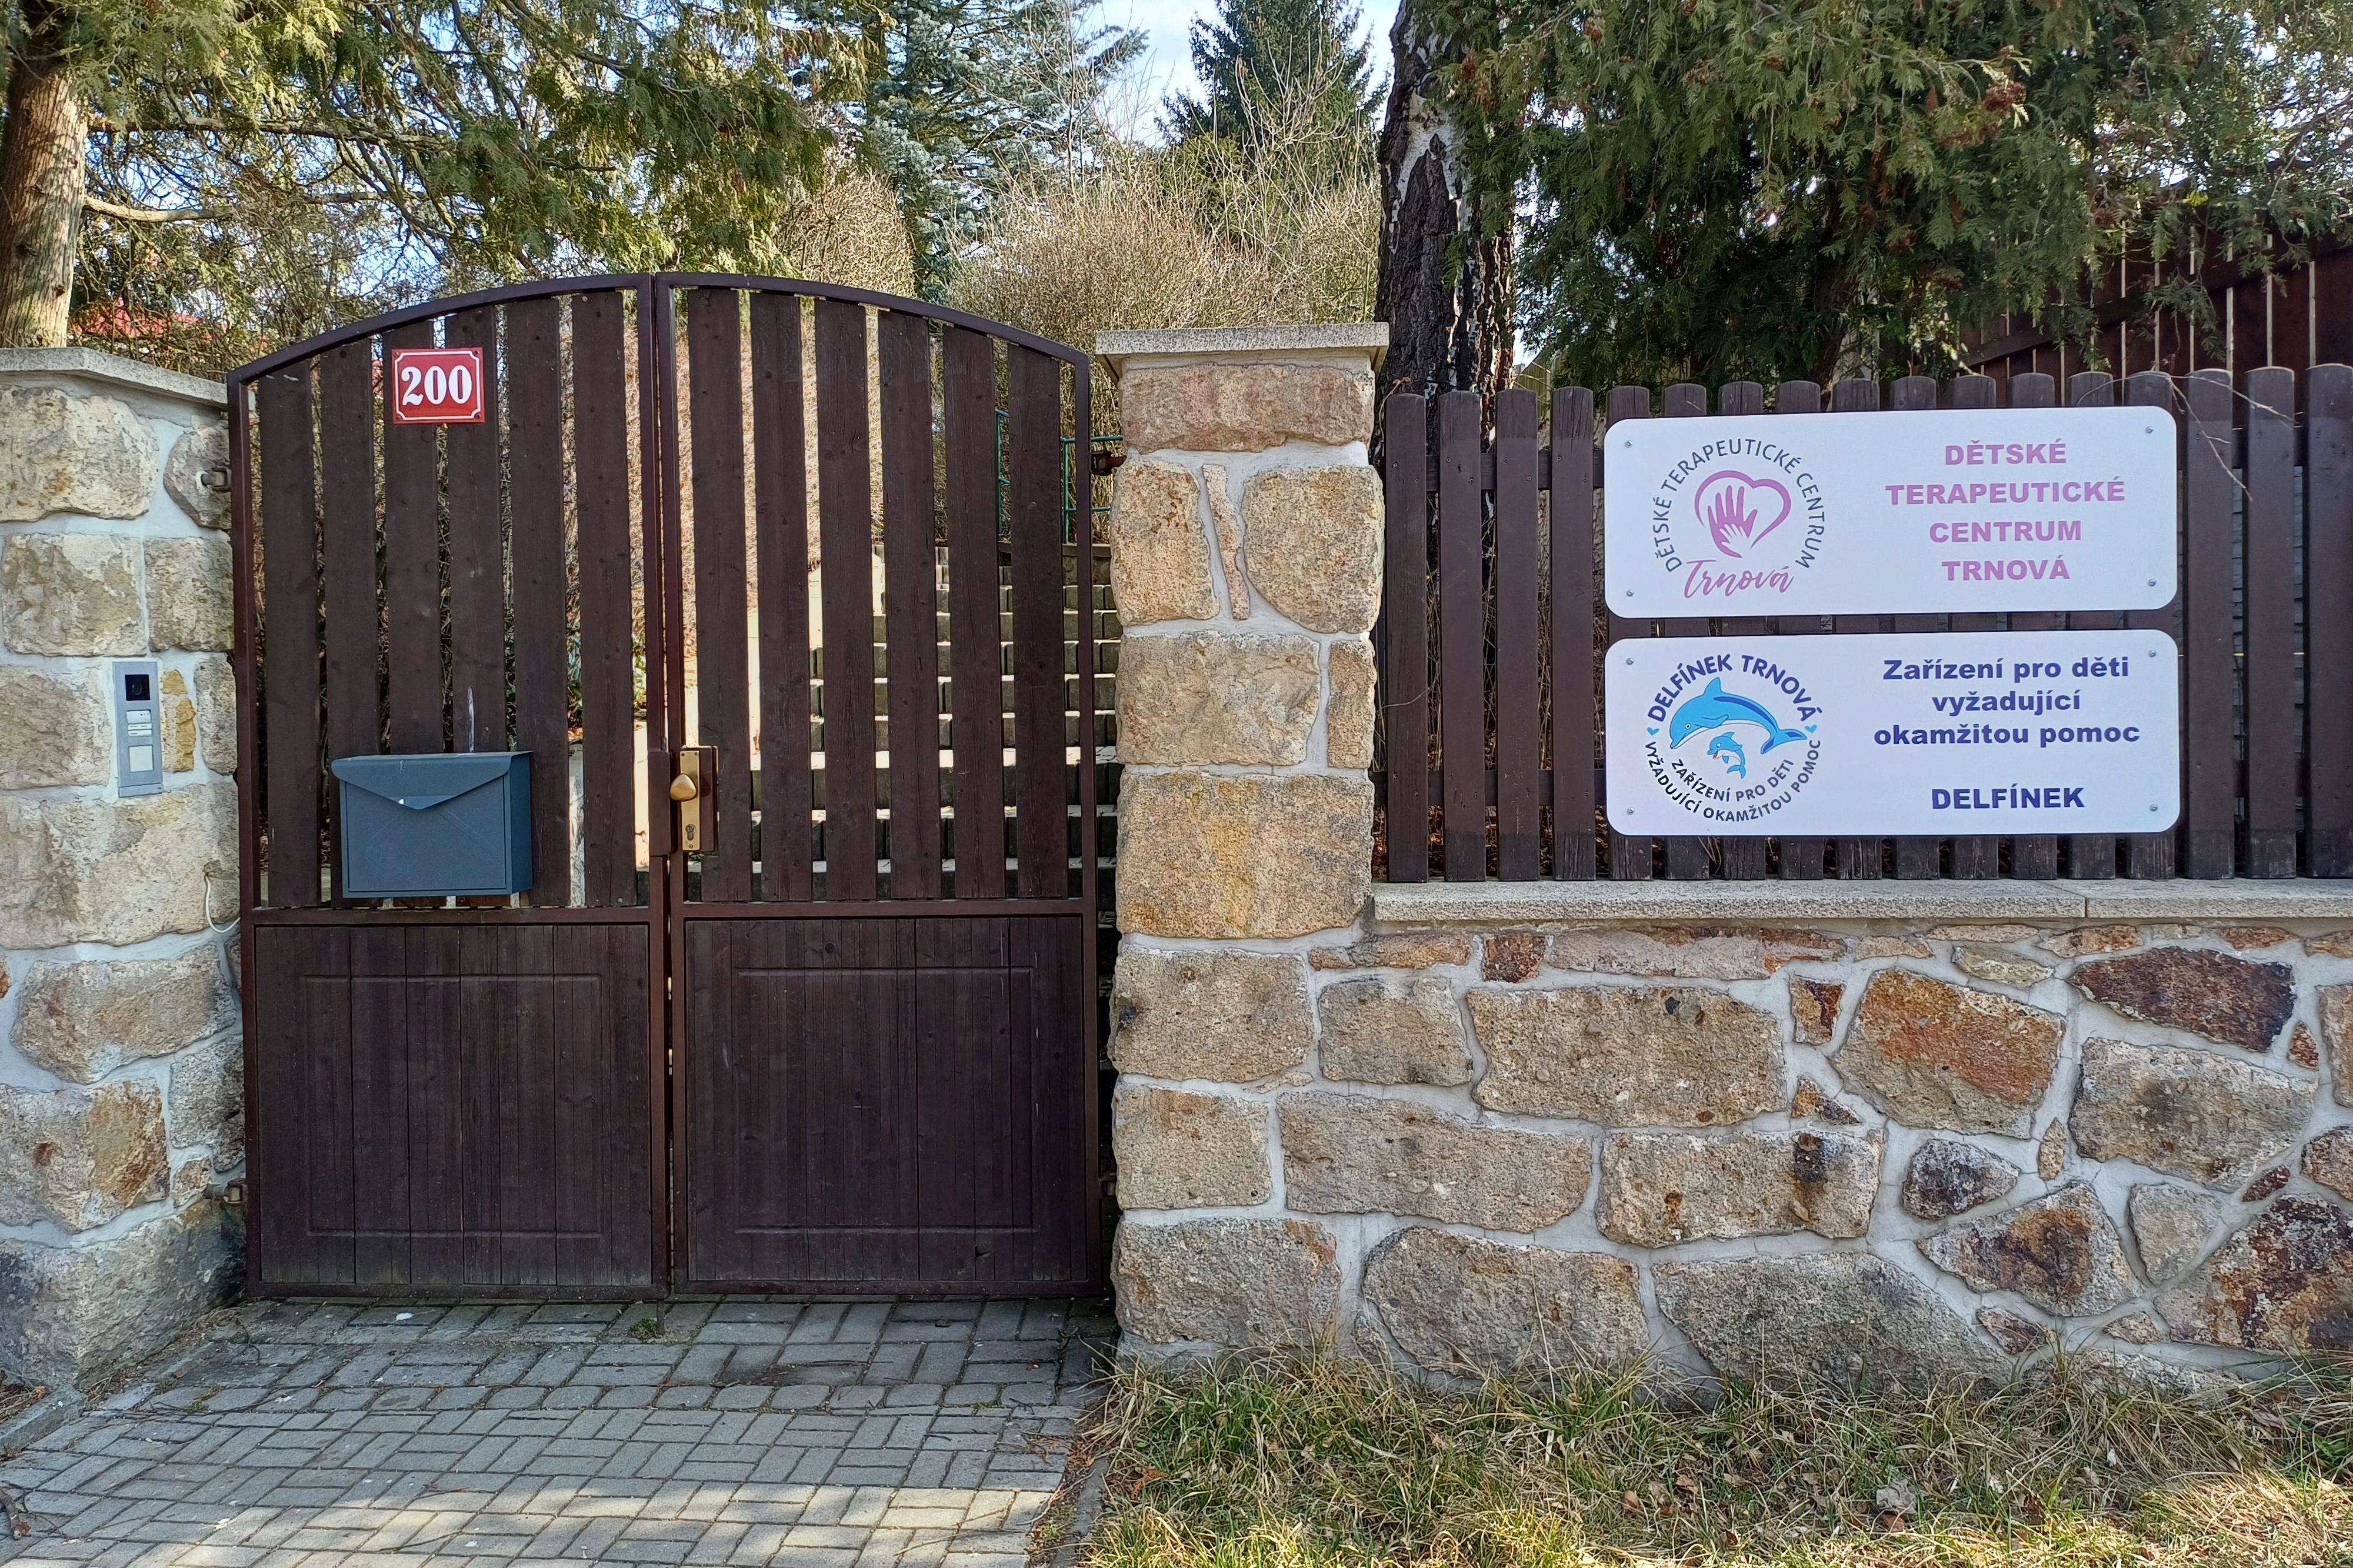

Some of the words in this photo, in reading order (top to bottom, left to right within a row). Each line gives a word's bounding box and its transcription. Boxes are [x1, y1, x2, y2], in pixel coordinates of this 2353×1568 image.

[401, 365, 472, 405] 200
[1661, 439, 1802, 492] TERAPEUTICKÉ
[1946, 439, 2067, 465] DĚTSKÉ
[1885, 476, 2125, 505] TERAPEUTICKÉ
[1653, 497, 1683, 572] DĚTSKÉ
[1795, 473, 1825, 569] CENTRUM
[1929, 521, 2081, 542] CENTRUM
[1684, 559, 1794, 599] Trnová
[1942, 555, 2070, 581] TRNOVÁ
[1883, 658, 2004, 680] Zařízení
[2014, 662, 2061, 683] pro
[2072, 656, 2129, 678] děti
[1648, 654, 1733, 722] DELFÍNEK
[1741, 655, 1822, 722] TRNOVÁ
[1932, 689, 2081, 716] vyžadující
[1874, 724, 2029, 745] okamžitou
[2039, 726, 2141, 748] pomoc
[1645, 741, 1702, 813] VYŽADUJÍCÍ
[1703, 791, 1792, 822] OKAMŽITOU
[1791, 739, 1821, 793] POMOC
[1671, 759, 1731, 802] ZAŘÍZENÍ
[1735, 785, 1766, 802] PRO
[1767, 759, 1794, 788] DĚTI
[1932, 783, 2085, 809] DELFÍNEK
